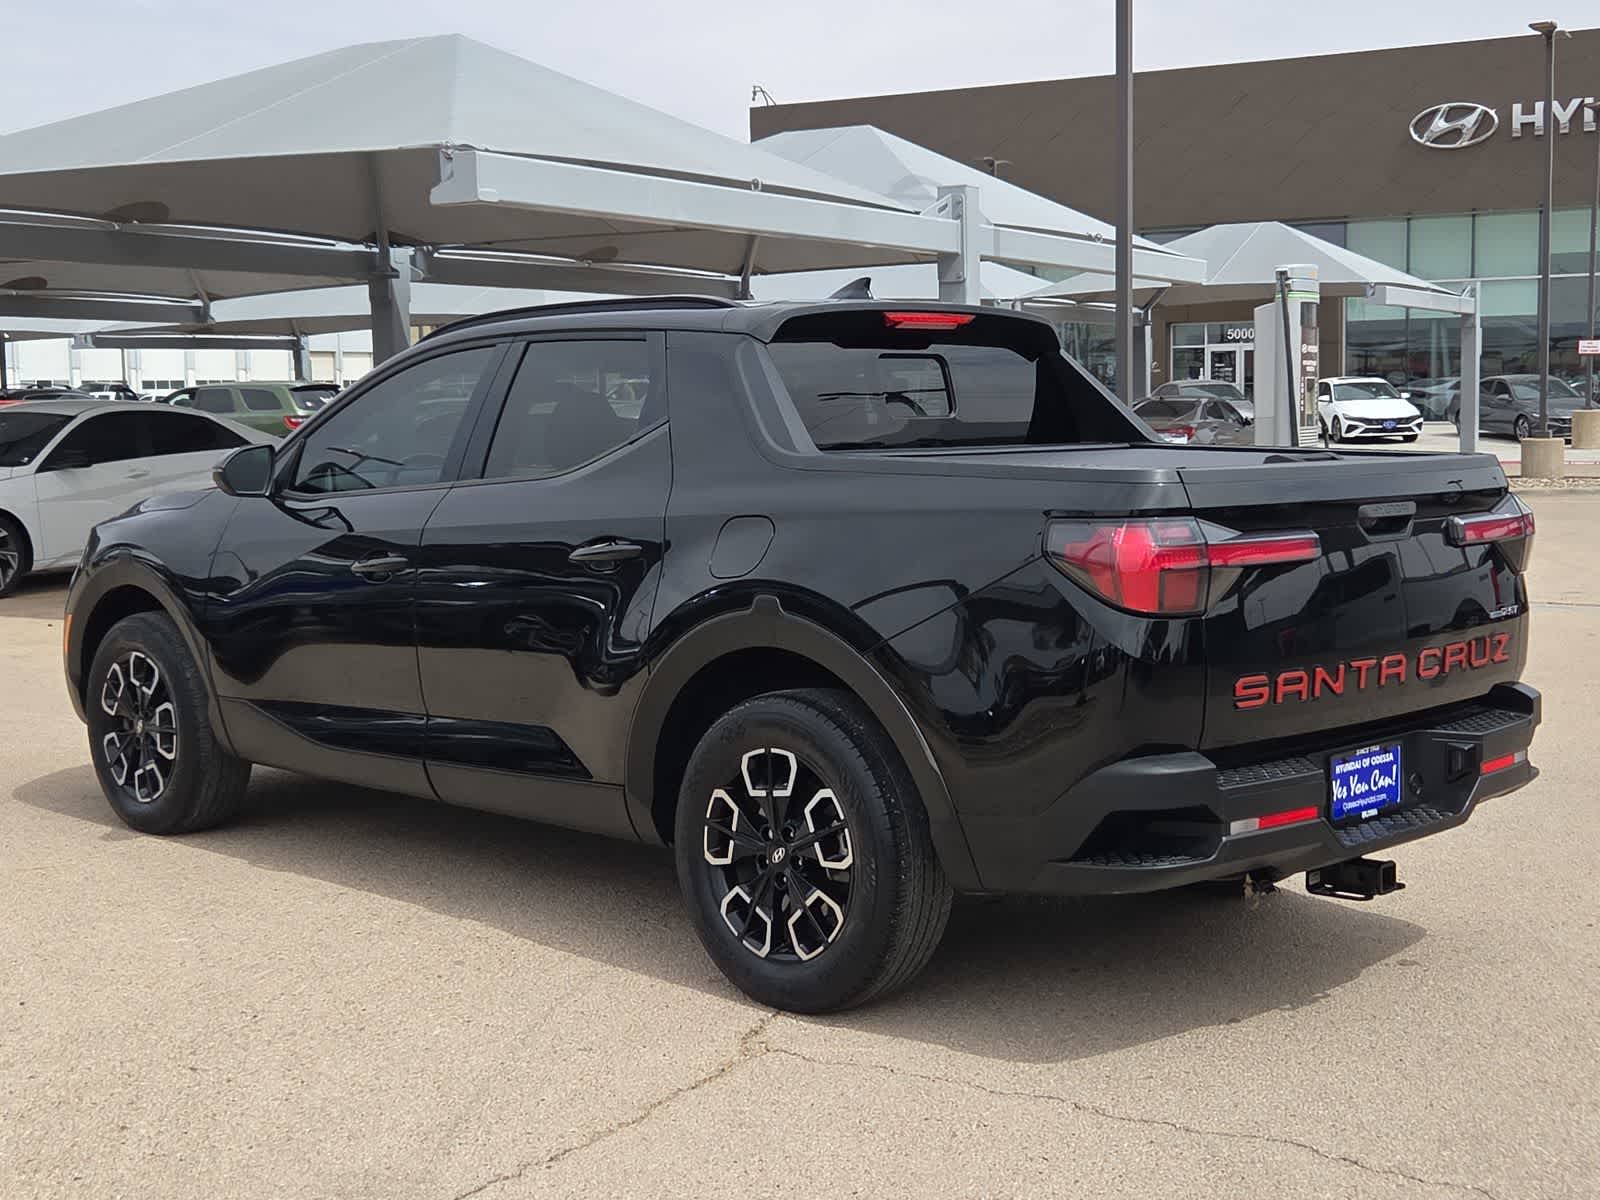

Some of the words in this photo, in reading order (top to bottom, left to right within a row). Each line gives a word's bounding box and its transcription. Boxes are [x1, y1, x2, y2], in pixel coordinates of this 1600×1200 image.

[1227, 328, 1255, 340] 5000
[1234, 654, 1408, 709] SANTA
[1416, 632, 1512, 680] CRUZ
[1335, 760, 1361, 774] HYUNDAI
[1362, 757, 1370, 768] OF
[1371, 752, 1394, 765] ODESSA
[1332, 779, 1348, 802] Yes
[1350, 774, 1369, 797] You
[1370, 764, 1397, 791] Can!
